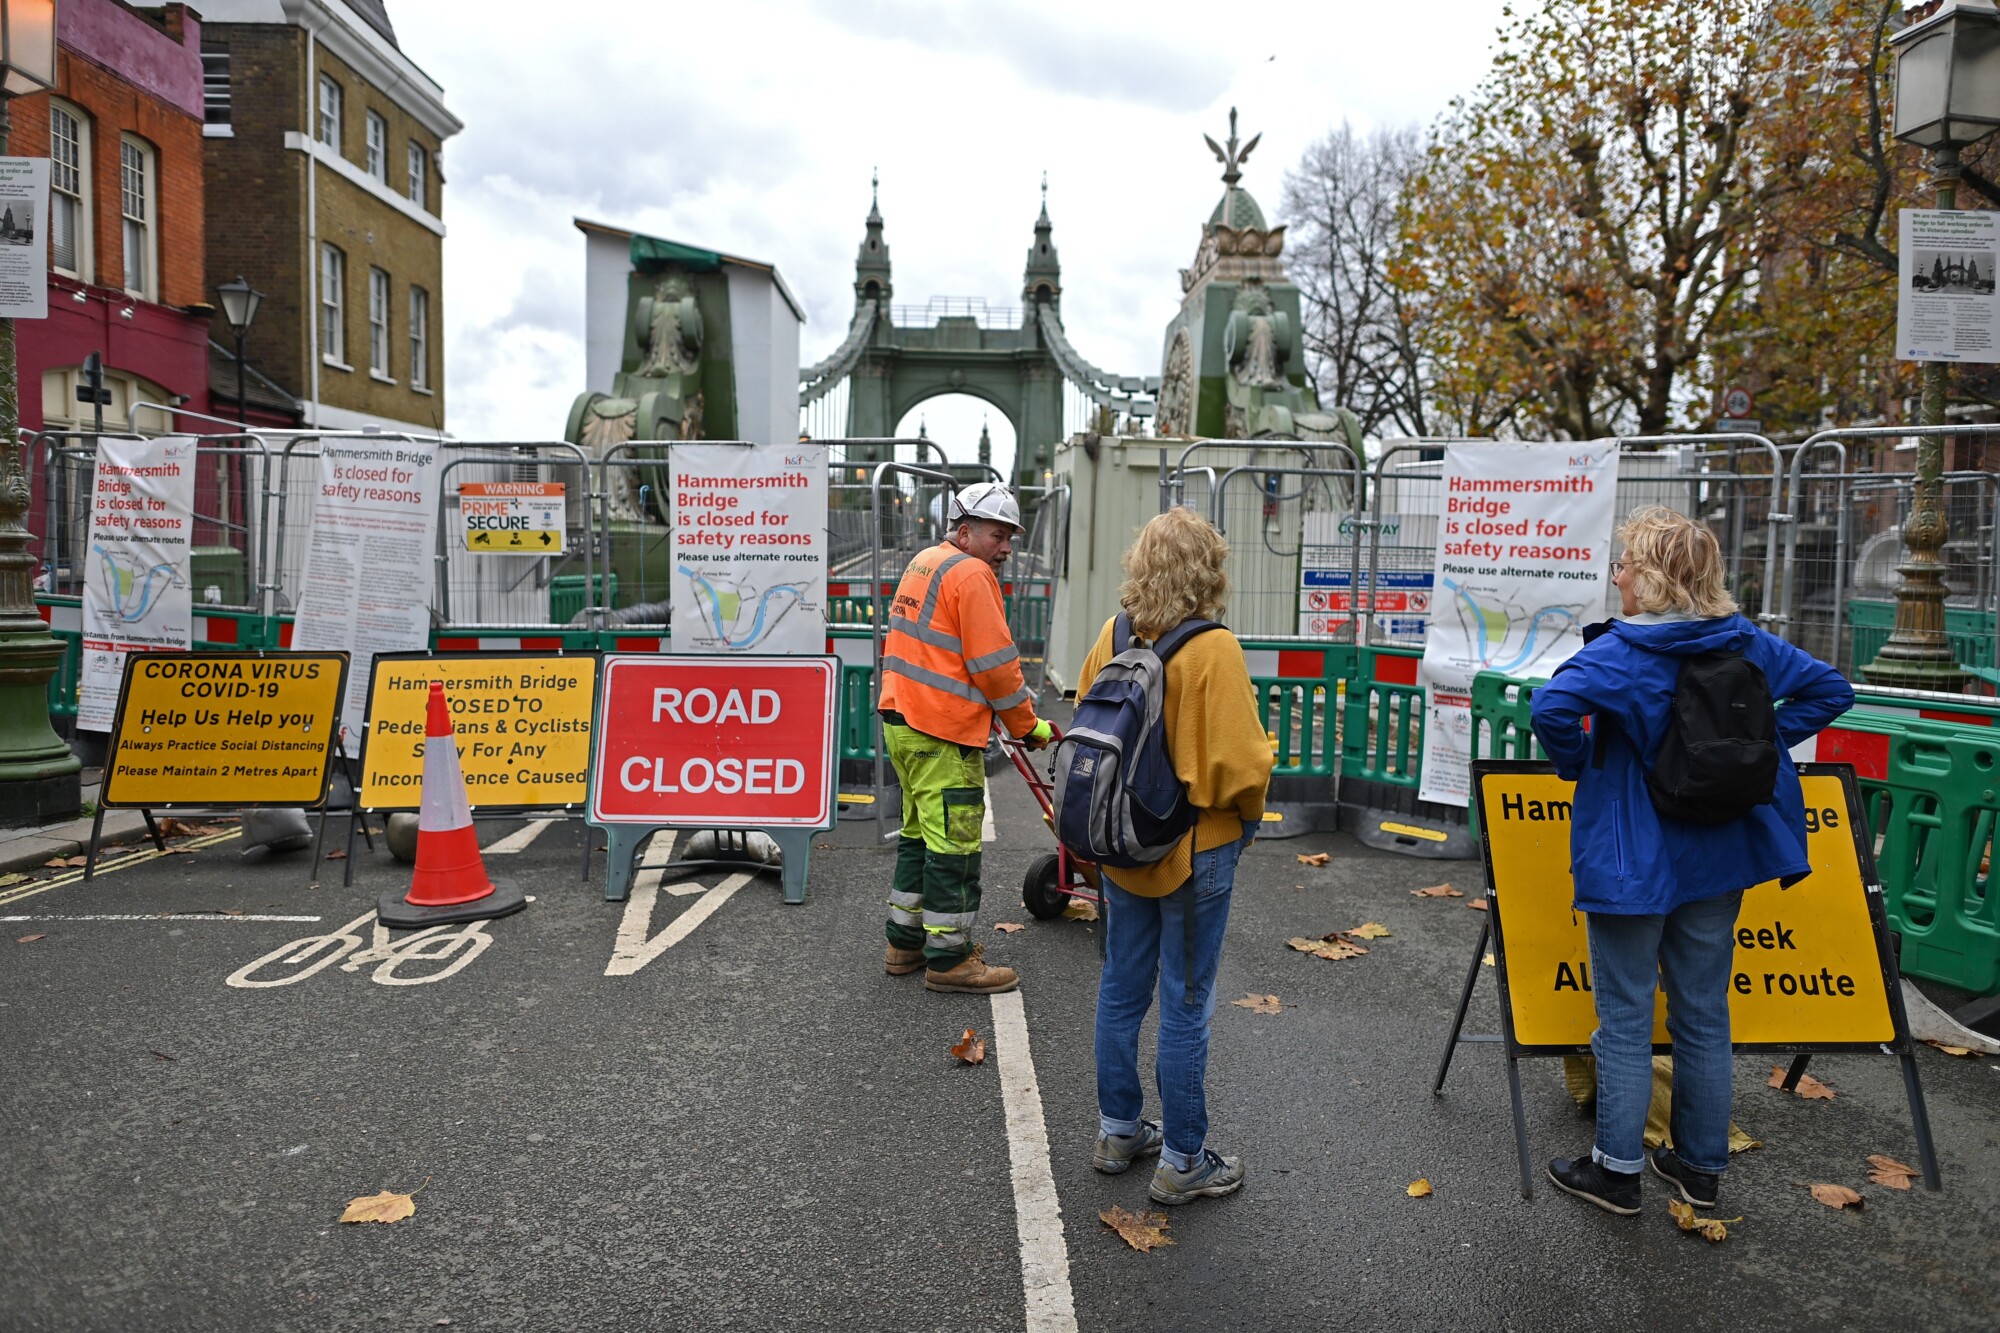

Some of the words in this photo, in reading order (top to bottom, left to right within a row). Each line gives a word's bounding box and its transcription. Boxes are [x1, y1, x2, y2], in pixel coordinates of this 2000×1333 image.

[322, 446, 393, 461] Hammersmith
[396, 451, 433, 467] Bridge
[785, 455, 803, 466] h&f
[1569, 455, 1590, 466] h&f
[99, 463, 180, 477] Hammersmith
[334, 464, 343, 479] is
[346, 465, 388, 482] closed
[392, 468, 414, 484] for
[98, 480, 131, 496] Bridge
[678, 473, 808, 489] Hammersmith
[1450, 475, 1593, 493] Hammersmith
[322, 482, 361, 503] safety
[364, 488, 422, 504] reasons
[484, 484, 545, 495] WARNING
[96, 496, 105, 509] is
[110, 496, 142, 511] closed
[147, 497, 166, 511] for
[462, 502, 509, 516] PRIME
[678, 492, 738, 511] Bridge
[1448, 497, 1511, 518] Bridge
[95, 513, 130, 530] safety
[134, 518, 182, 529] reasons
[468, 516, 530, 530] SECURE
[678, 511, 691, 526] is
[697, 511, 754, 526] closed
[761, 511, 789, 526] for
[1338, 522, 1400, 535] CONAY
[1446, 518, 1459, 534] is
[1466, 519, 1528, 536] closed
[1536, 519, 1567, 537] for
[94, 533, 114, 541] Please
[131, 535, 161, 544] alternate
[162, 536, 185, 544] routes
[678, 530, 735, 549] safety
[740, 533, 812, 545] reasons
[677, 552, 709, 562] Please
[712, 554, 731, 562] use
[734, 552, 780, 562] alternate
[784, 553, 819, 562] routes
[1444, 539, 1503, 561] safety
[1509, 545, 1591, 561] reasons
[1443, 563, 1475, 574] Please
[1479, 567, 1498, 576] use
[1500, 566, 1554, 578] alternate
[1558, 569, 1598, 581] routes
[127, 635, 164, 644] Hammersmith
[166, 638, 186, 646] Bridge
[145, 663, 242, 678] CORONA
[252, 663, 321, 679] VIRUS
[181, 682, 279, 698] COVID-19
[521, 675, 578, 691] Bridge
[1433, 682, 1468, 694] Distances
[426, 699, 510, 713] OSED
[518, 698, 543, 713] TO
[653, 688, 781, 724] ROAD
[1453, 698, 1470, 706] Bridge
[141, 709, 187, 728] Help
[195, 710, 220, 726] Us
[227, 710, 272, 728] Help
[280, 712, 315, 728] you
[378, 720, 489, 735] Pedeians
[496, 720, 508, 734] &
[515, 719, 589, 736] Cyclists
[120, 740, 163, 752] Always
[167, 740, 216, 751] Practice
[221, 740, 257, 751] Social
[262, 740, 324, 752] Distancing
[473, 743, 503, 757] For
[510, 742, 547, 759] Any
[117, 765, 158, 776] Please
[162, 765, 217, 776] Maintain
[221, 766, 229, 776] 2
[234, 766, 278, 776] Metres
[282, 766, 318, 777] Apart
[372, 772, 510, 786] Inconence
[517, 769, 588, 784] Caused
[620, 756, 805, 794] CLOSED
[1734, 921, 1796, 950] eek
[1764, 967, 1855, 997] route
